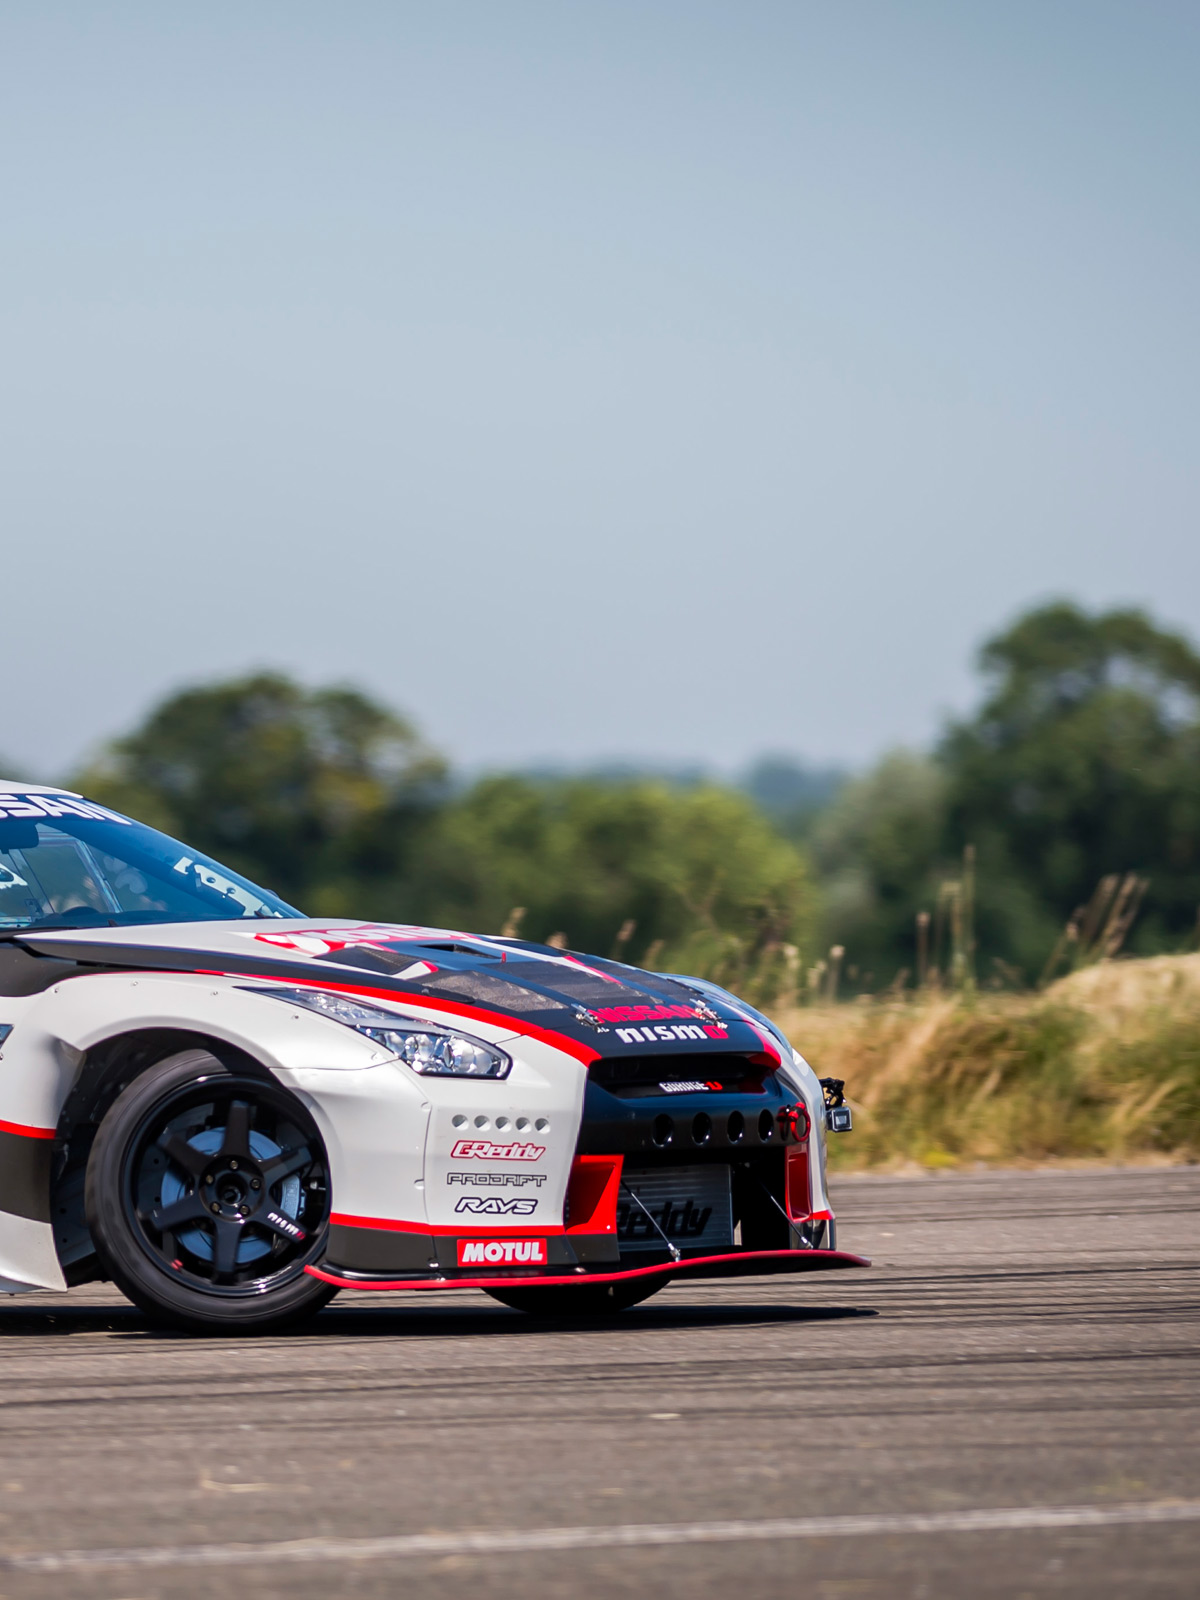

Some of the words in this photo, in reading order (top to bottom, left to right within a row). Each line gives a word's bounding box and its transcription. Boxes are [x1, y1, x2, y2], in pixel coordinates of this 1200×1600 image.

[615, 1024, 729, 1044] nismo
[451, 1140, 546, 1161] GReddy
[446, 1172, 547, 1187] PRODRIFT
[455, 1197, 538, 1215] RAYS
[461, 1242, 544, 1262] MOTUL
